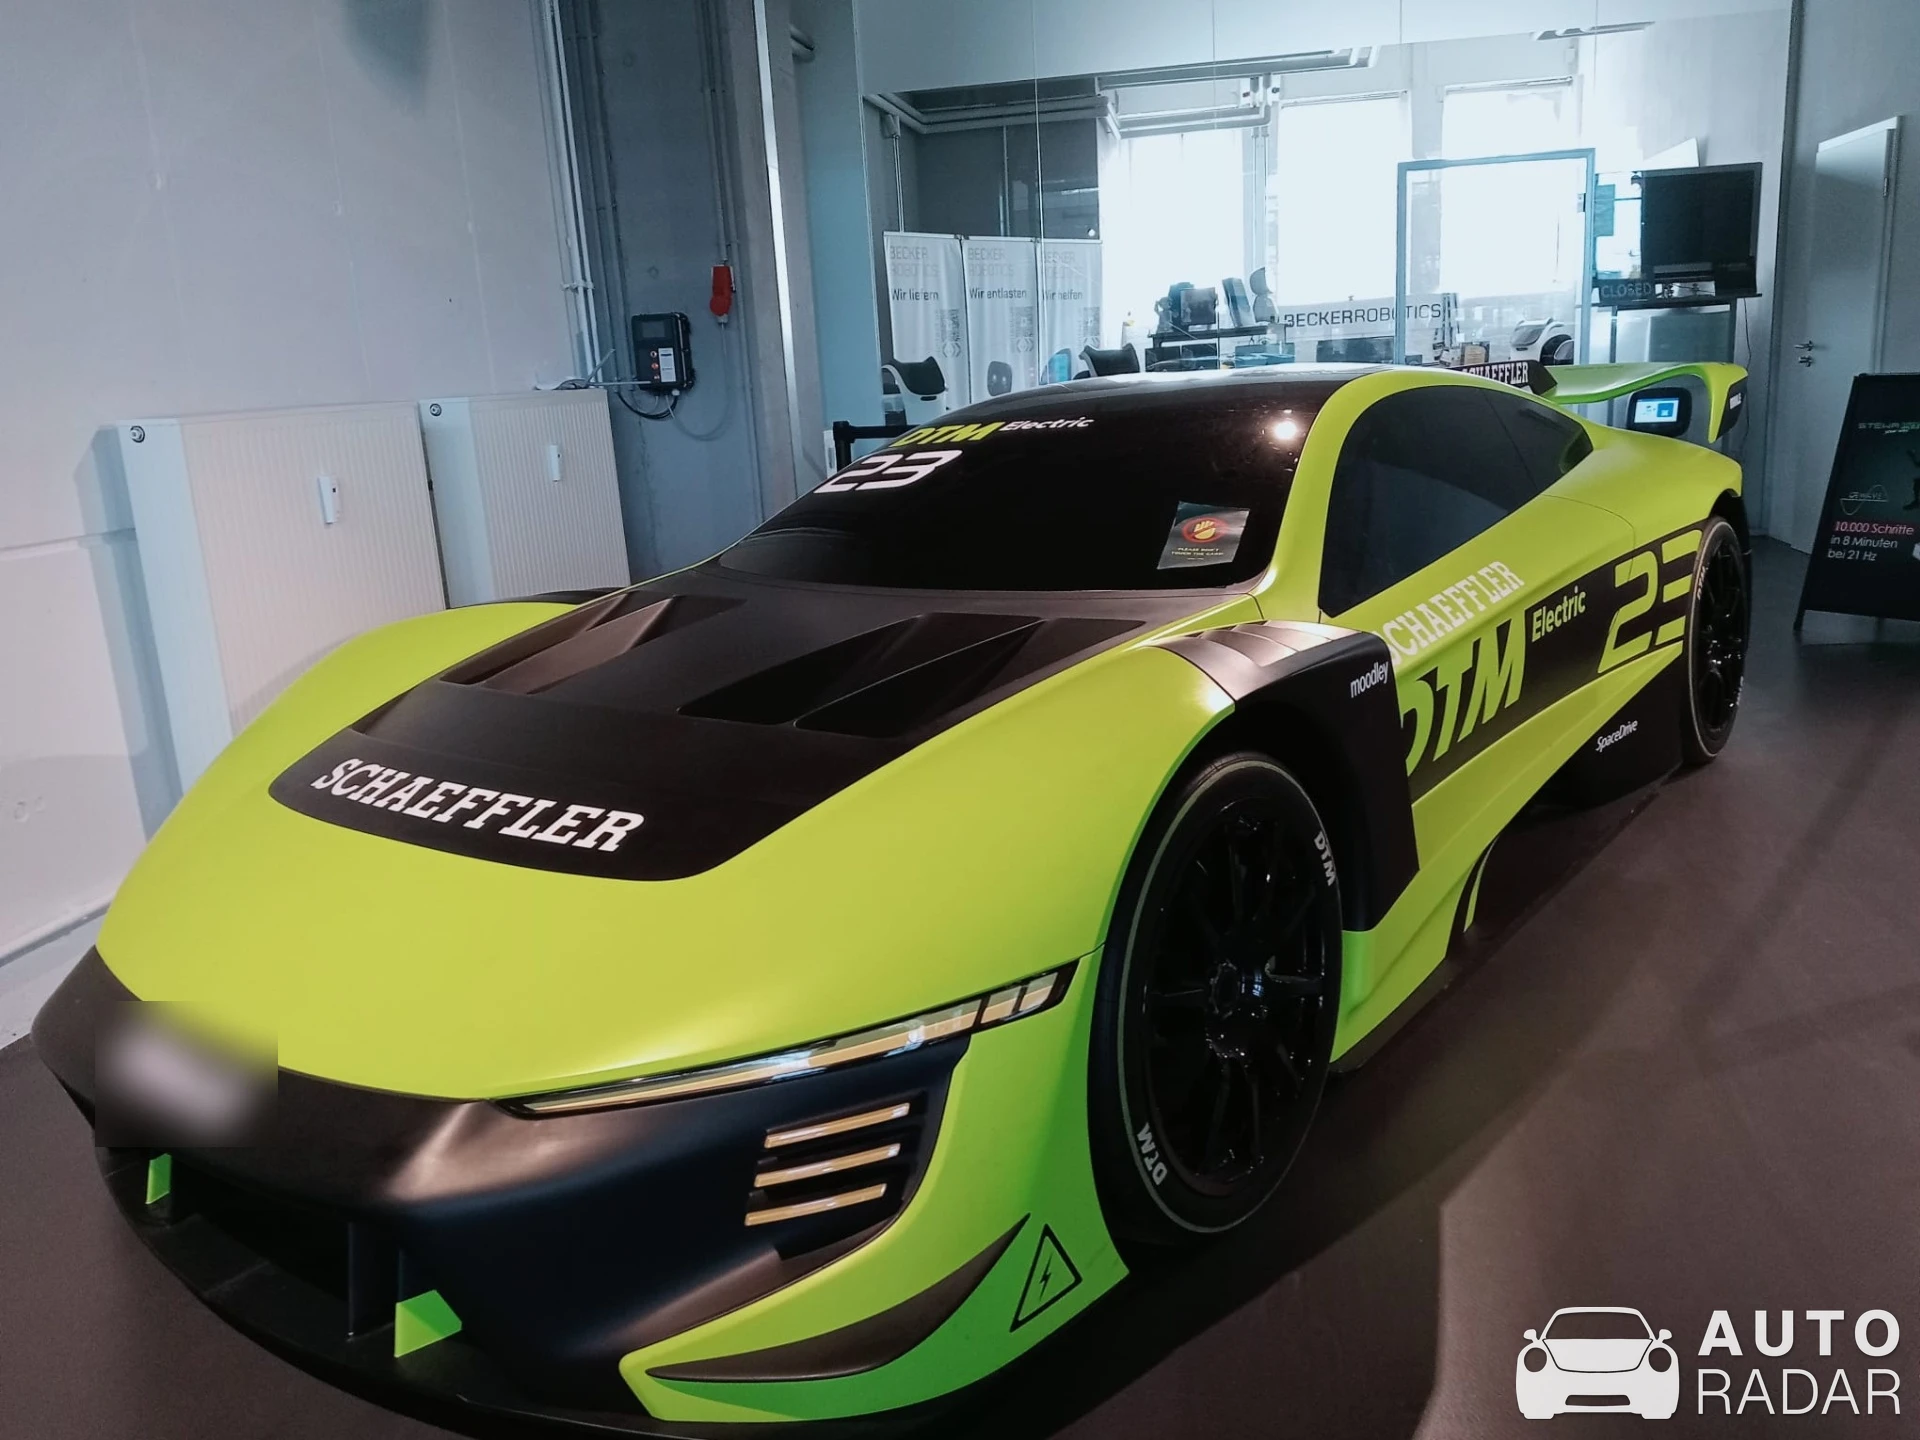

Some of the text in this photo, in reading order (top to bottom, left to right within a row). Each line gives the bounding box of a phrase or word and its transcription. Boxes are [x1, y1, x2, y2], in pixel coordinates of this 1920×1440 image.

[892, 288, 906, 301] Wir
[969, 287, 1027, 299] Wir entlasten
[1600, 282, 1652, 298] CLOSED
[889, 416, 1095, 448] DTM Electric
[813, 450, 963, 494] 23
[1830, 534, 1898, 549] in 8 Minuten
[1834, 520, 1914, 536] 10.000 Schritte
[1827, 548, 1878, 562] bei 21 Hz
[1531, 585, 1587, 643] Electric
[1350, 660, 1389, 698] moodley
[1595, 719, 1638, 753] SpaceDrive
[310, 758, 645, 852] SCHAEFFLER
[1313, 830, 1338, 887] DTM
[1136, 1121, 1169, 1187] DTM
